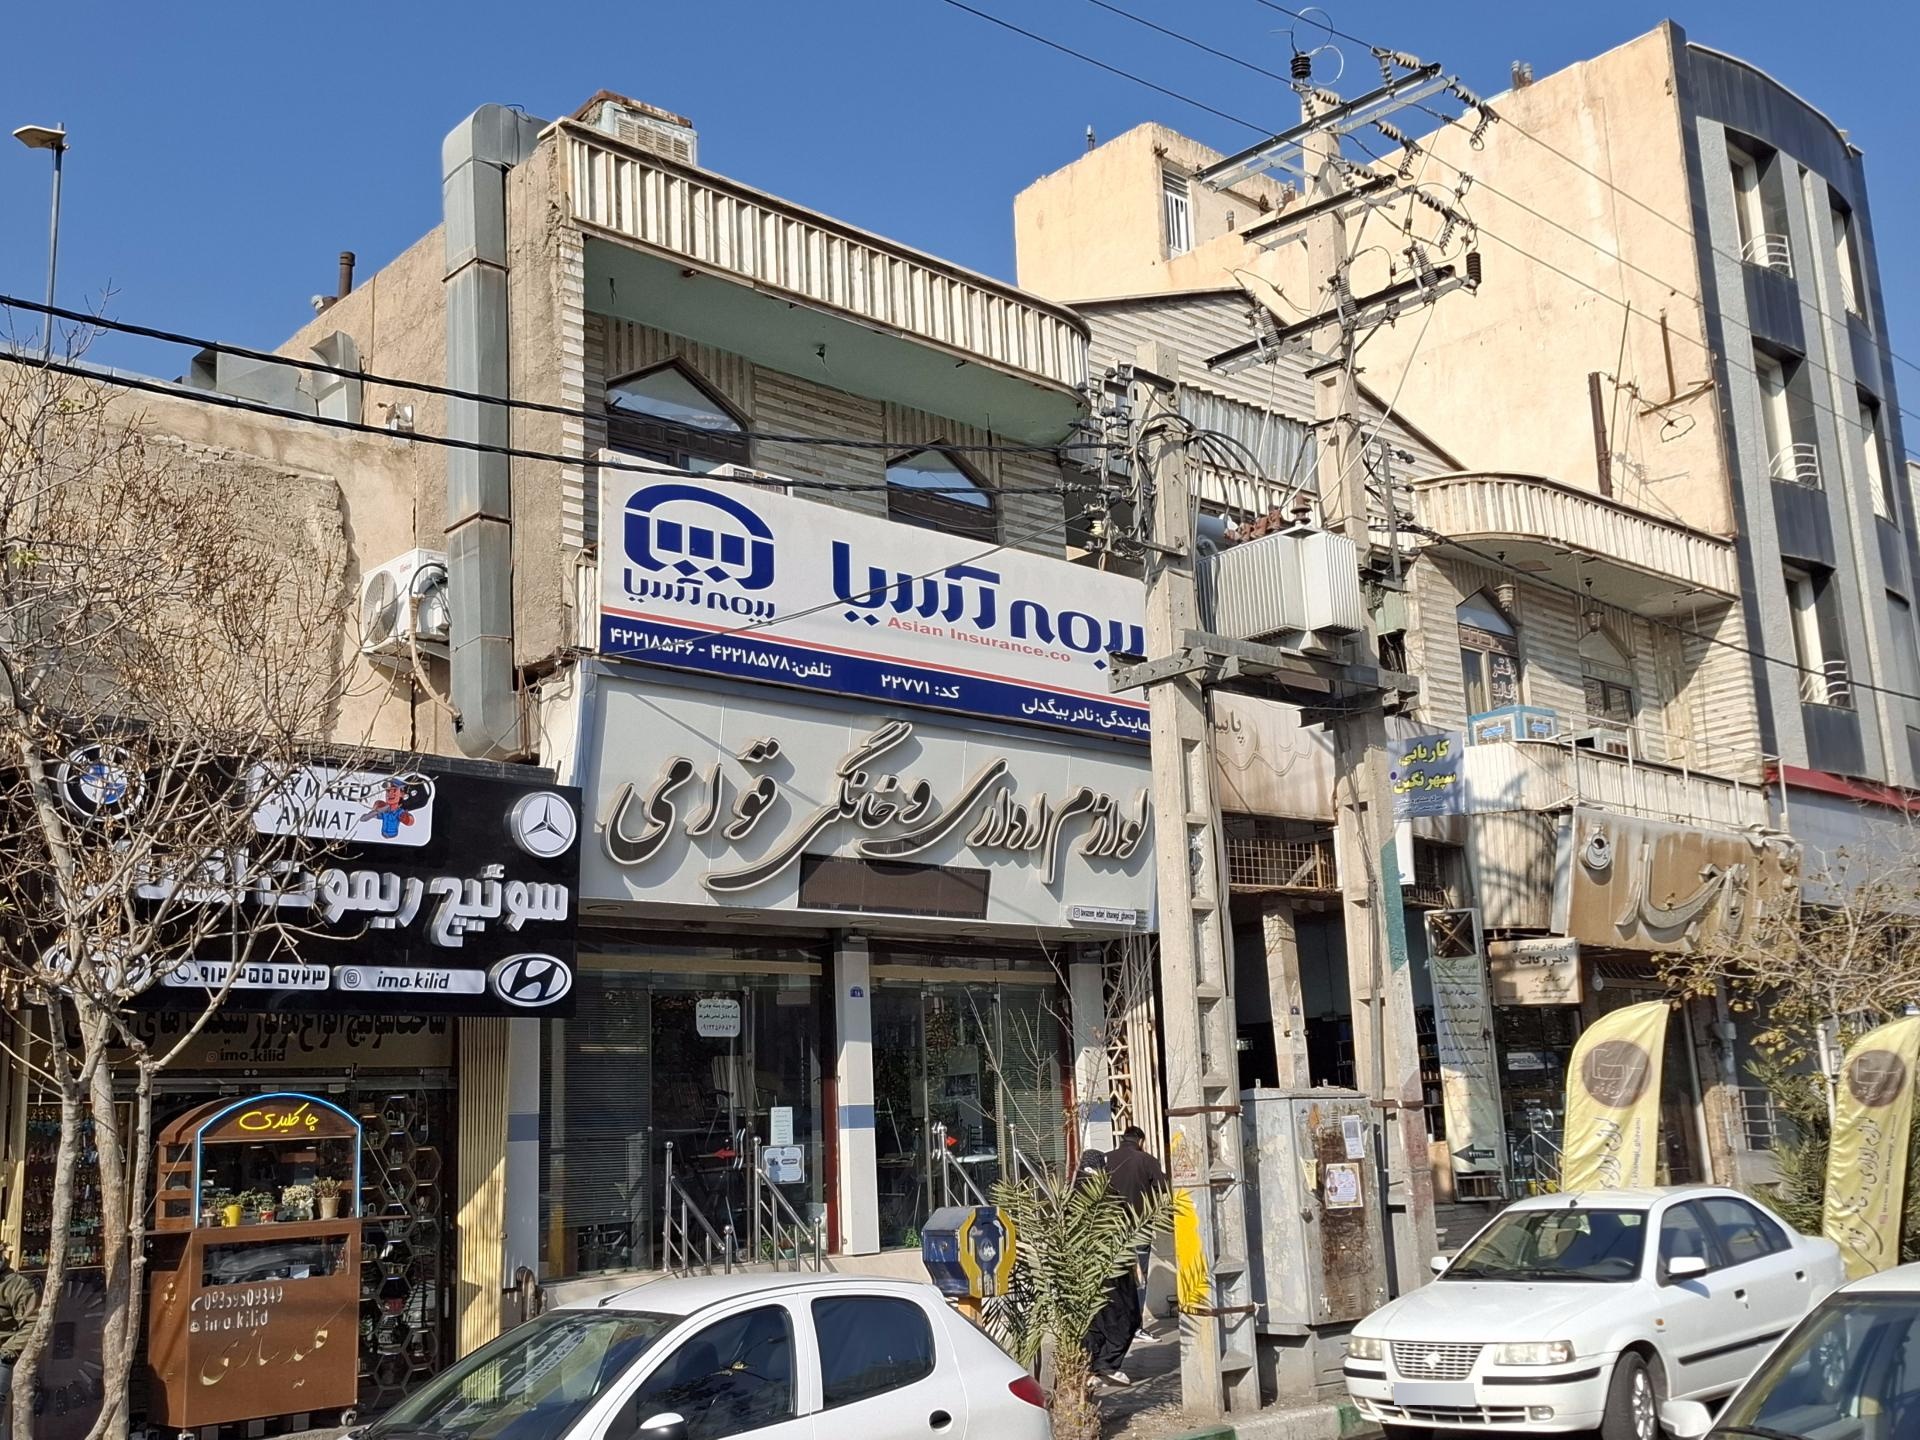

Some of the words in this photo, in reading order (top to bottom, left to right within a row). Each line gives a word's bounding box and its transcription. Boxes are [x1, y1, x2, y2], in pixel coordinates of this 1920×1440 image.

[623, 567, 704, 604] آسیا
[831, 540, 1000, 627] آسیا
[706, 591, 775, 625] بیمه
[887, 616, 944, 638] Asian
[950, 626, 1072, 663] Insurance.co
[710, 643, 790, 671] ۴۲۲۱۸۵۷۸
[881, 674, 929, 695] ۲۲۷۷۱
[934, 684, 960, 699] کد:
[1021, 698, 1072, 720] بیگدلی
[1073, 708, 1094, 722] نادر
[1096, 709, 1151, 733] مایندگی:
[1398, 740, 1450, 767] کاریابی
[605, 736, 782, 866] قوامی
[703, 719, 913, 892] خانگی
[854, 756, 1048, 859] اداری
[898, 777, 933, 825] و
[1040, 785, 1149, 885] لوازم
[428, 863, 570, 948] سوئیچ
[376, 970, 450, 990] imo.kilid
[219, 1049, 286, 1063] imo.kilid
[239, 1101, 310, 1134] کلیدی
